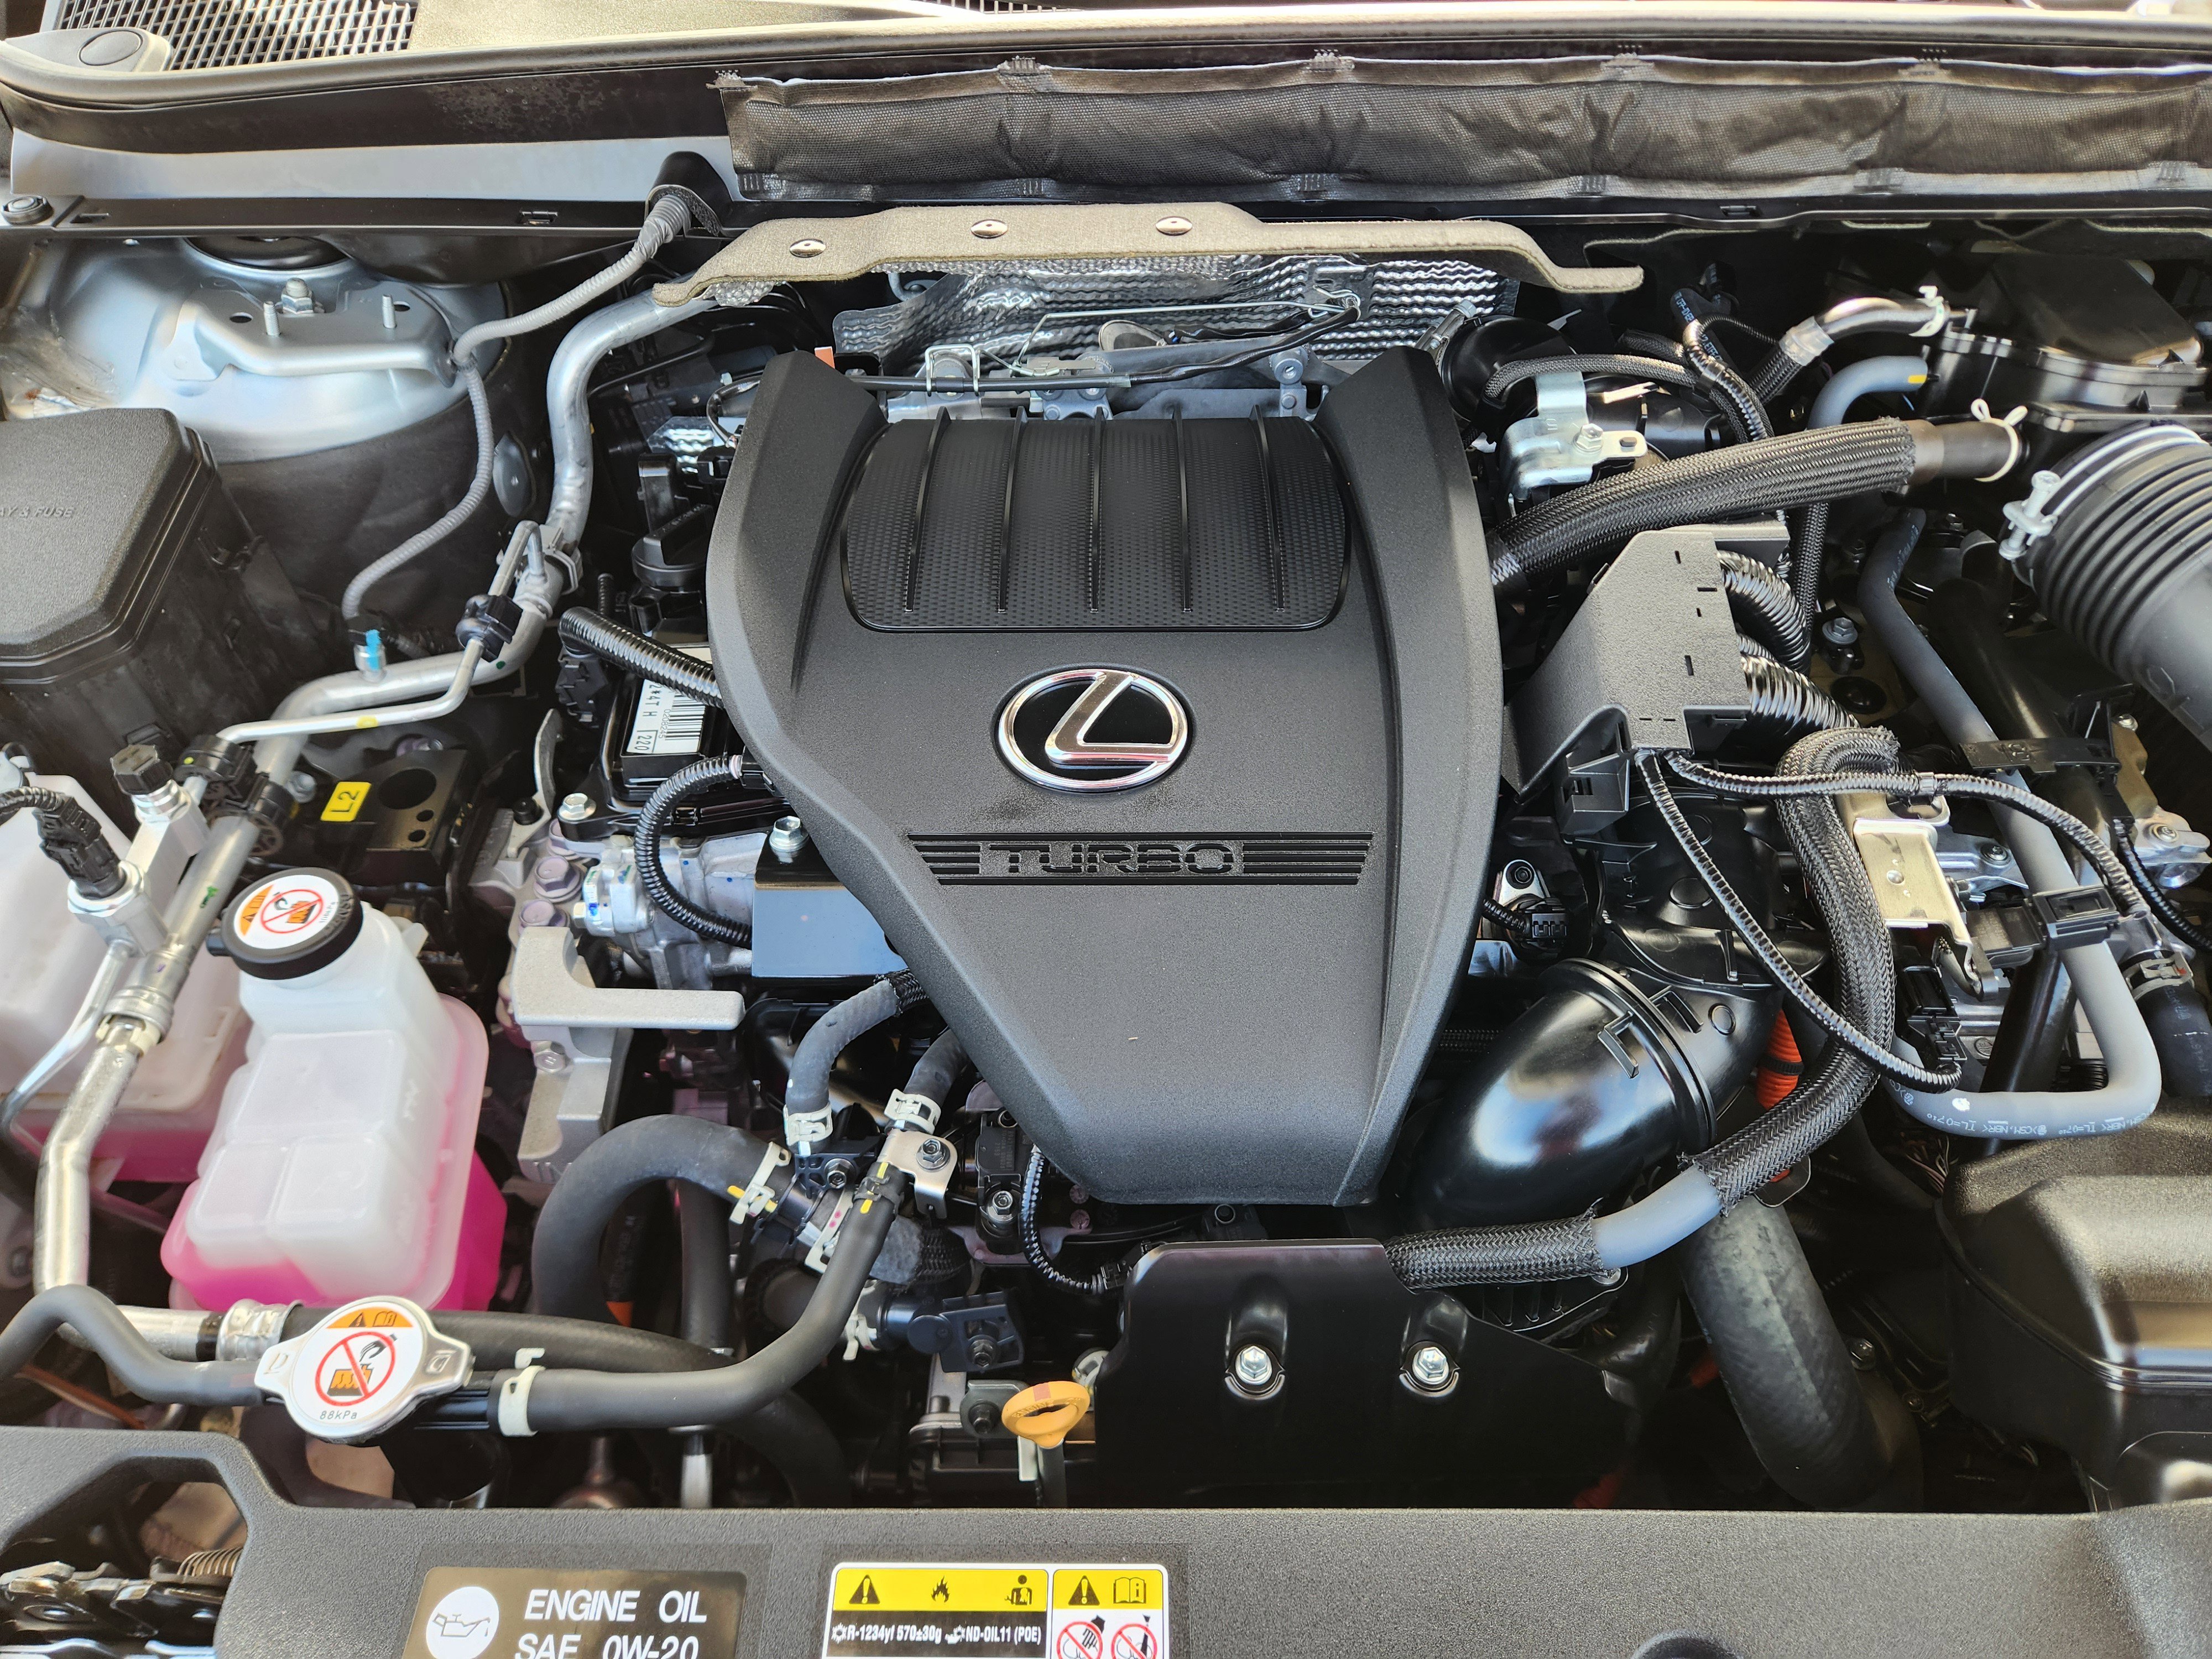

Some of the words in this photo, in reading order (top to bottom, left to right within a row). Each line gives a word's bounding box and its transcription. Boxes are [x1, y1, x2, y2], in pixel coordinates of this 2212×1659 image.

[34, 505, 75, 518] FUSE
[659, 708, 671, 739] 0208245
[634, 735, 653, 750] 220
[330, 790, 360, 812] L2
[988, 842, 1234, 874] TURBO
[320, 1410, 358, 1420] 88kPa
[524, 1589, 641, 1622] ENGINE
[659, 1590, 707, 1623] OIL
[515, 1633, 582, 1659] SAE
[603, 1635, 699, 1659] 0W-20
[897, 1625, 942, 1645] 570±30g
[966, 1625, 1011, 1643] ND-OIL11
[1014, 1626, 1041, 1645] (POE)
